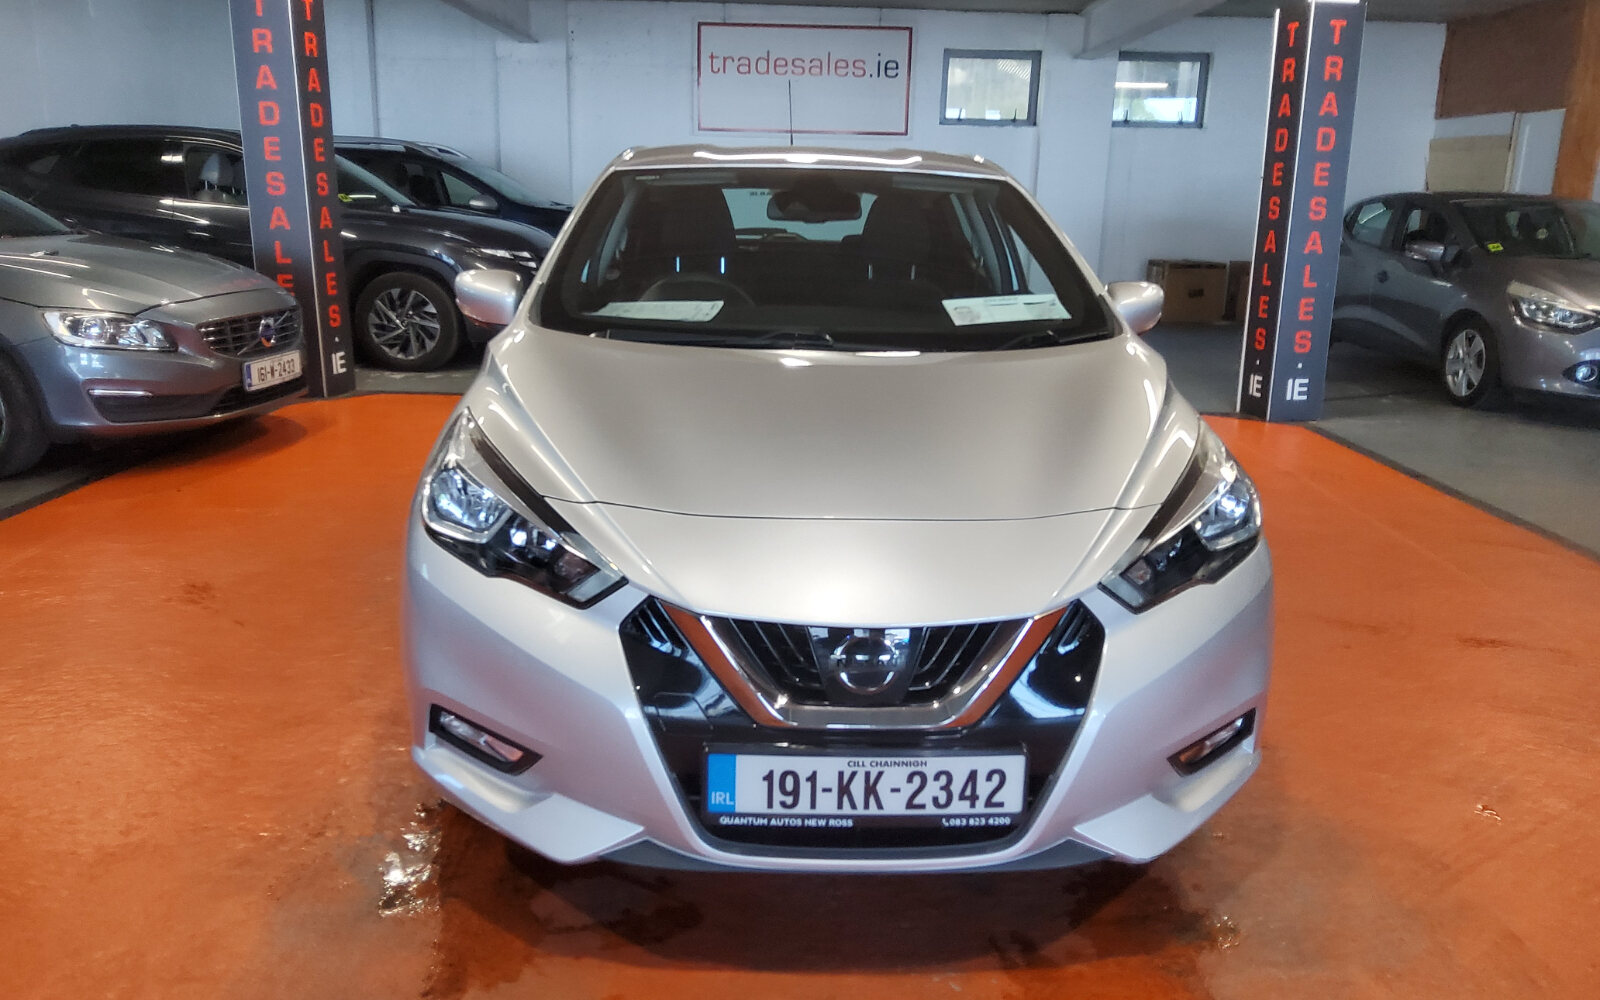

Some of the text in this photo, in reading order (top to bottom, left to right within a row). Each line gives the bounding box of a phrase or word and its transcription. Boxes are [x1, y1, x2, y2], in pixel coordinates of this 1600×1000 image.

[708, 50, 900, 79] tradesales.ie
[847, 760, 928, 768] CILL CHAINNIGH
[762, 768, 1007, 811] 191-KK-2342
[710, 791, 735, 806] IRL
[719, 815, 854, 827] QUANTUM AUTOS NEW ROSS
